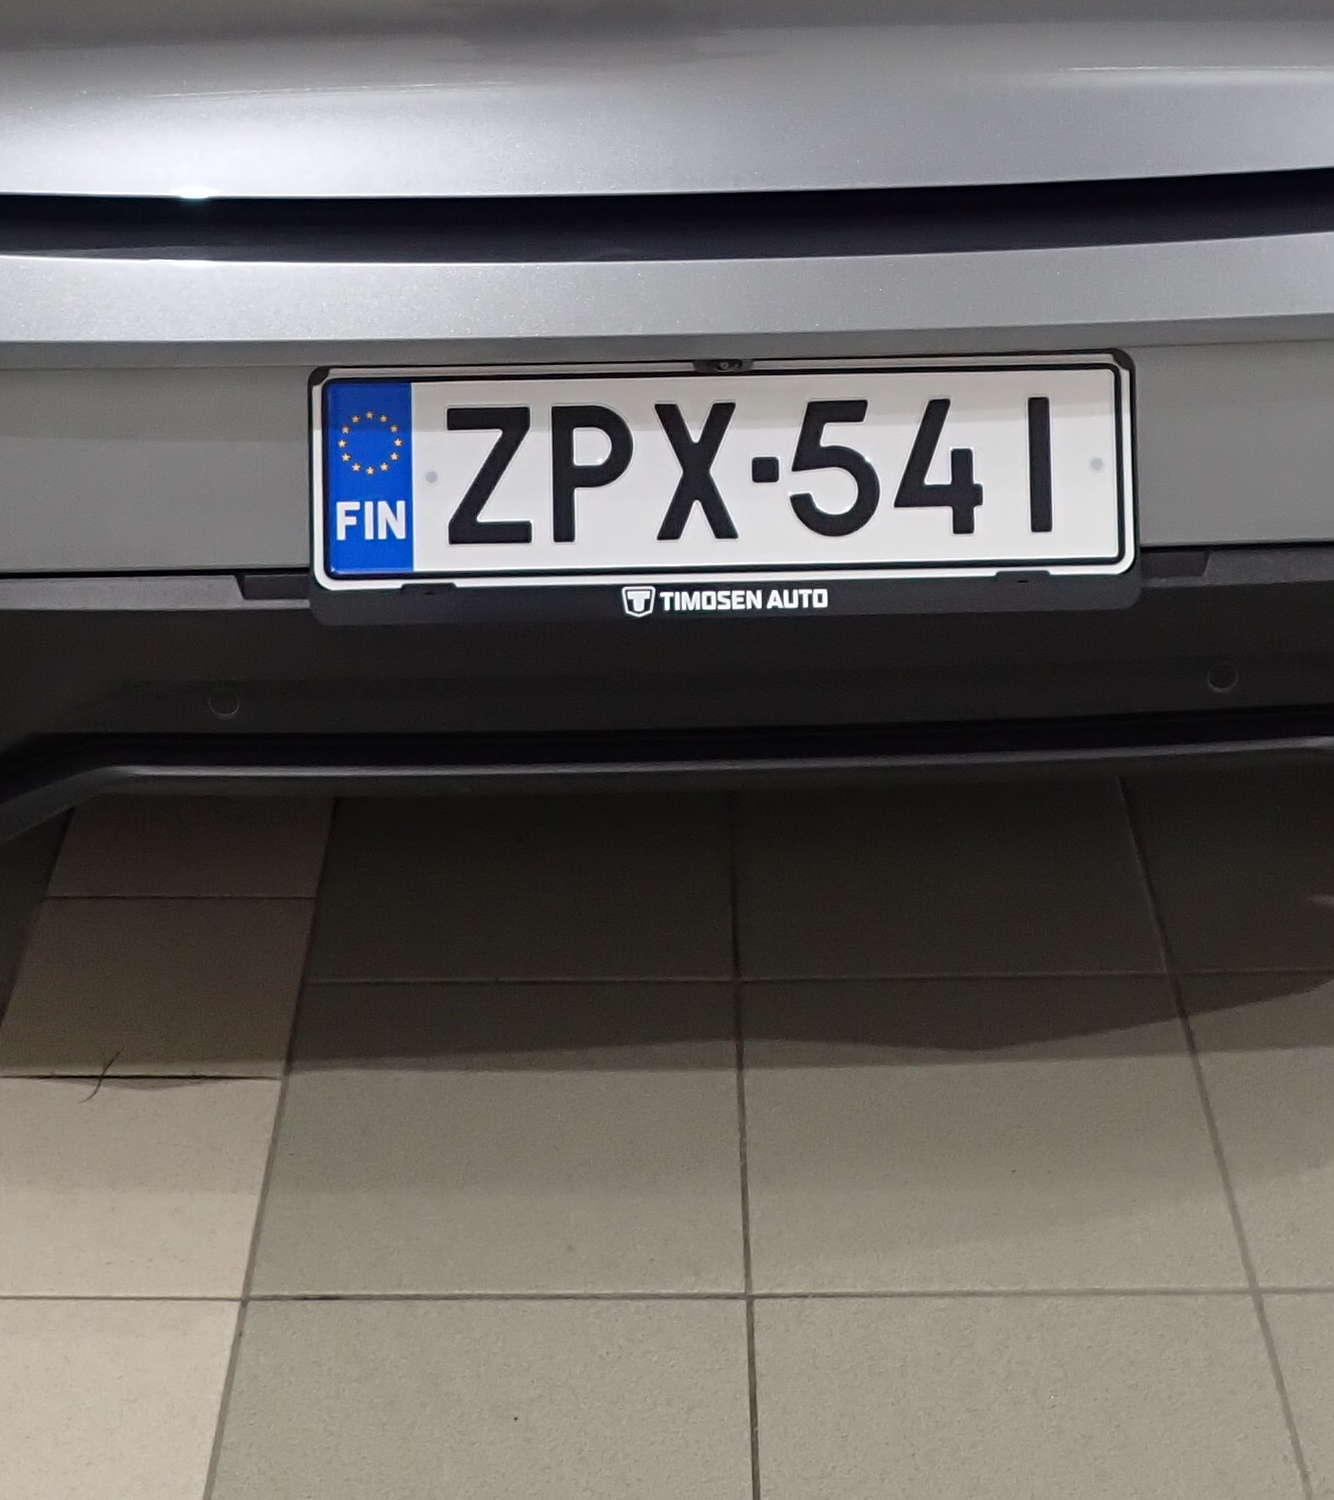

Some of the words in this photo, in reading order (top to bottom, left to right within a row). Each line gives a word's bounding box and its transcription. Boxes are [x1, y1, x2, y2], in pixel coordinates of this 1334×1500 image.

[446, 396, 1051, 545] ZPX-541
[336, 500, 407, 541] FIN
[659, 589, 763, 611] TIMOSEN
[766, 588, 829, 609] AUTO
